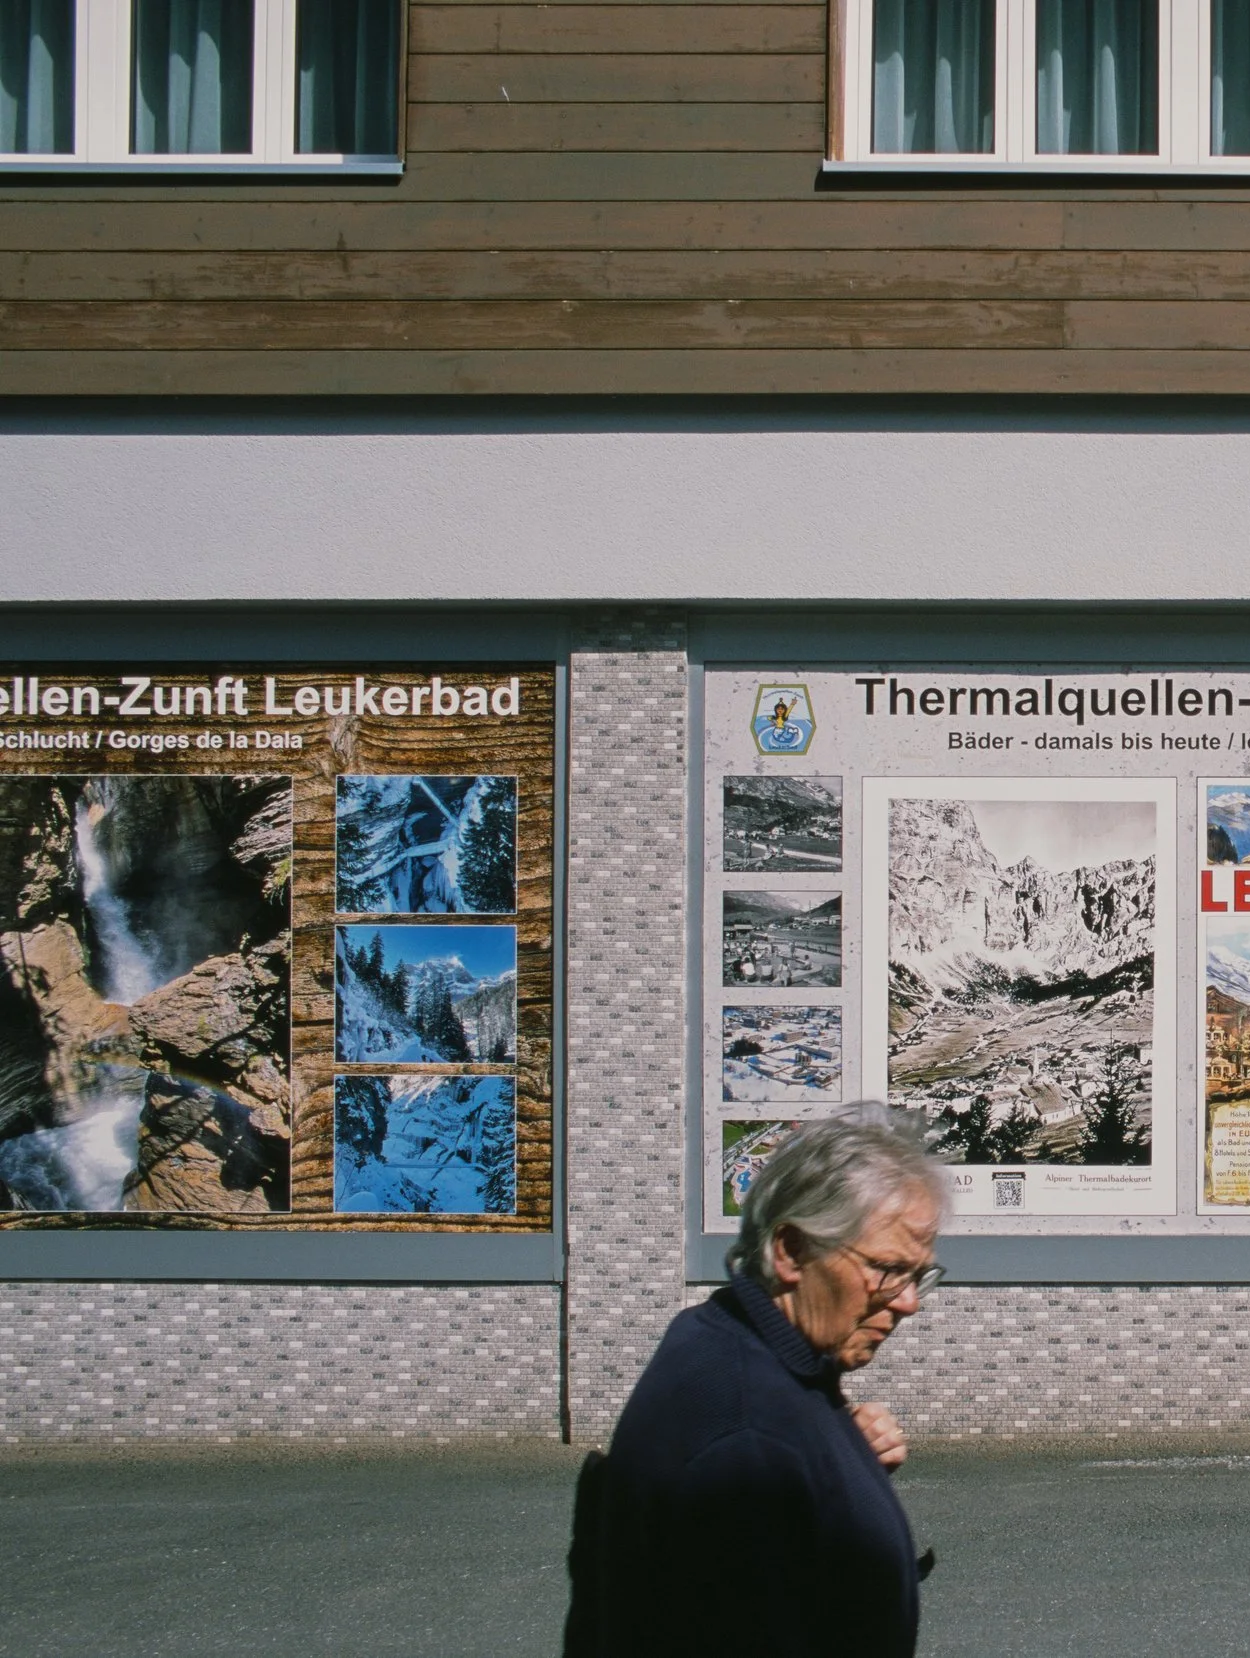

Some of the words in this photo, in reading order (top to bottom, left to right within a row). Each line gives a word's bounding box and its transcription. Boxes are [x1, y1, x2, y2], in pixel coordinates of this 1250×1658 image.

[265, 677, 520, 716] Leukerbad
[95, 730, 102, 749] /
[109, 730, 190, 753] Gorges
[196, 730, 222, 749] de
[230, 730, 248, 749] la
[255, 730, 303, 749] Dala
[948, 731, 1014, 750] Bäder
[1034, 731, 1113, 750] damals
[1121, 732, 1153, 750] bis
[1161, 732, 1221, 750] heute
[1045, 1174, 1072, 1183] Alpiner
[1078, 1174, 1151, 1183] Thermalbadekurort
